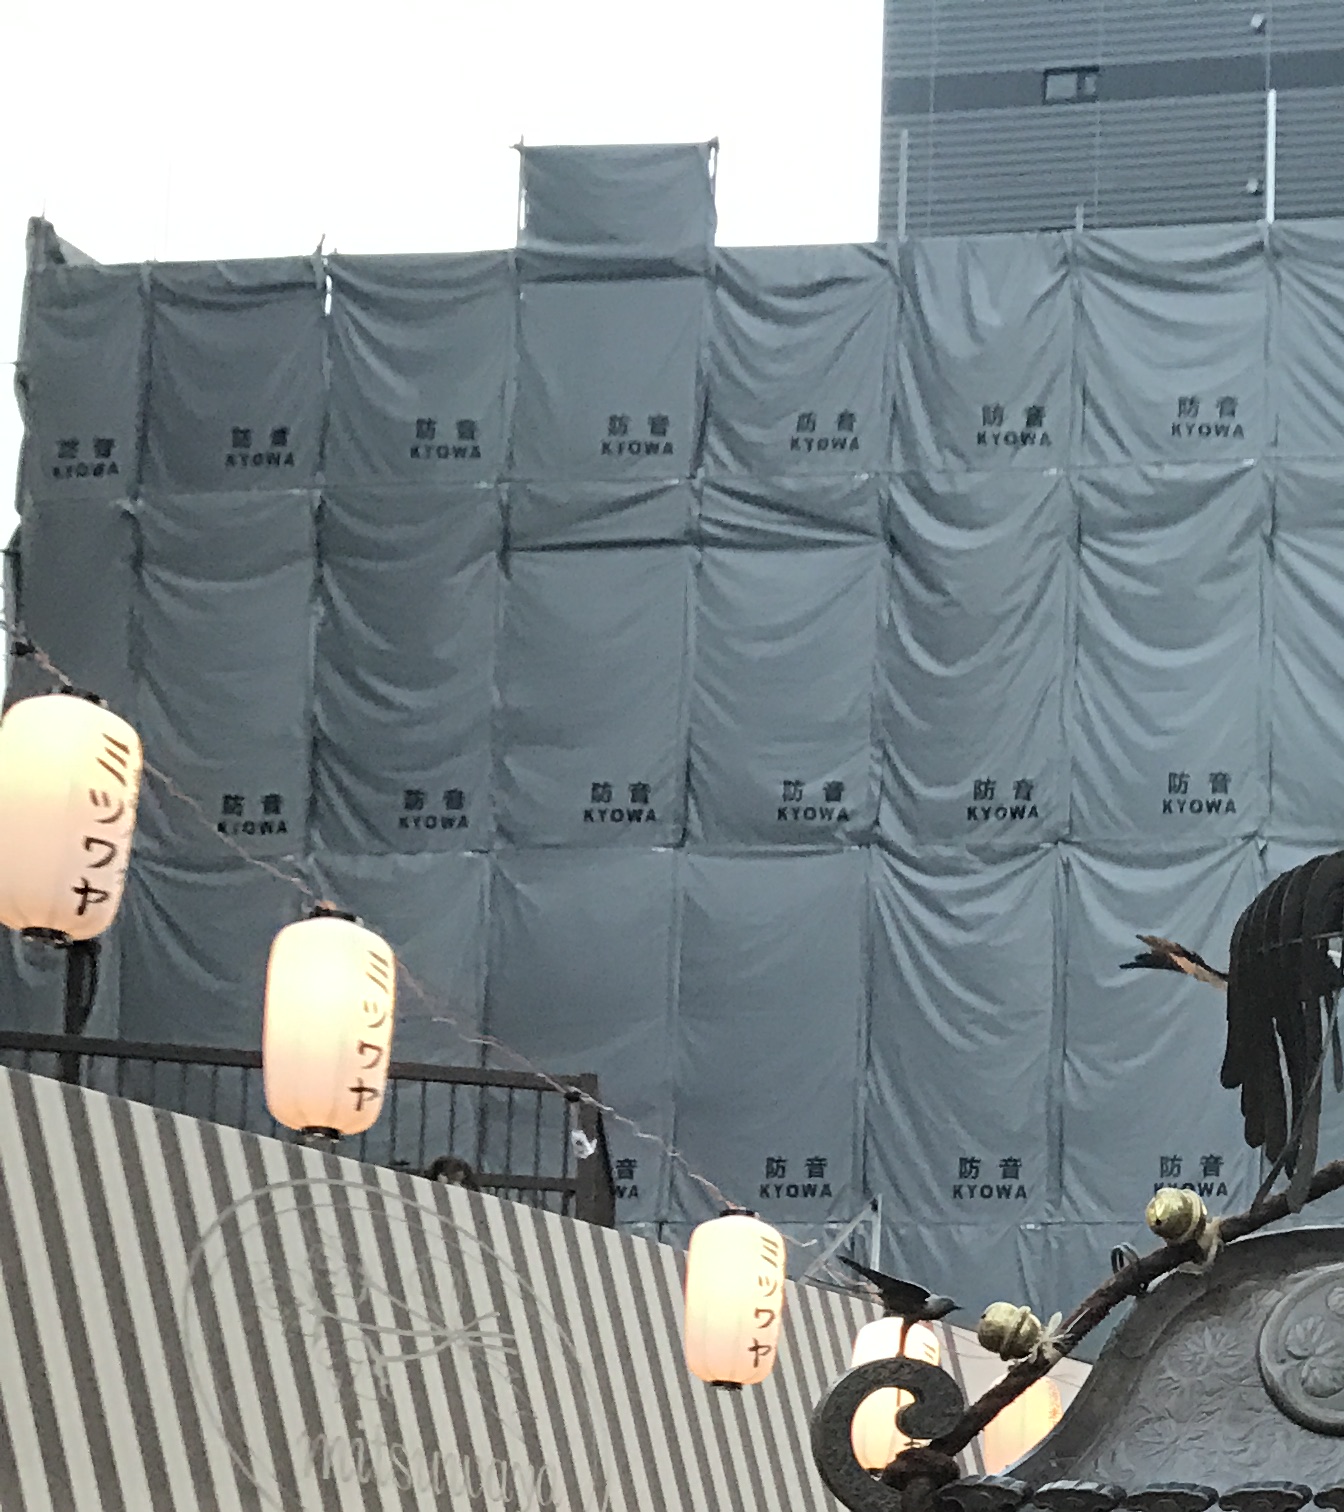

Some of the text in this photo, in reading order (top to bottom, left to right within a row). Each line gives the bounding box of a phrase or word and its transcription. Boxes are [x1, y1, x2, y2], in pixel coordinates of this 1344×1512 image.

[982, 403, 1046, 428] 防音
[1178, 395, 1239, 419] 防音
[415, 418, 477, 441] 防音
[608, 413, 670, 437] 防音
[796, 408, 857, 433] 防音
[1171, 421, 1244, 439] KYOWA
[601, 440, 674, 456] KYOWA
[790, 436, 860, 452] KYOWA
[977, 430, 1052, 447] KYOWA
[410, 444, 482, 460] KYOWA
[591, 782, 652, 804] 防音
[782, 780, 845, 802] 防音
[973, 778, 1034, 801] 防音
[1167, 771, 1232, 795] 防音
[404, 788, 465, 810] 防音
[1162, 798, 1236, 815] KYOWA
[400, 814, 469, 830] KYOWA
[583, 807, 657, 824] KYOWA
[777, 806, 850, 822] KYOWA
[967, 804, 1039, 821] KYOWA
[72, 733, 130, 916] ミツワヤ
[348, 951, 390, 1112] ミツワヤ
[616, 1158, 638, 1180] 音
[766, 1156, 828, 1180] 防音
[959, 1156, 1022, 1180] 防音
[1160, 1154, 1224, 1178] 防音
[759, 1182, 833, 1199] KYOWA
[953, 1183, 1027, 1200] KYOWA
[748, 1235, 779, 1368] ミツワヤ
